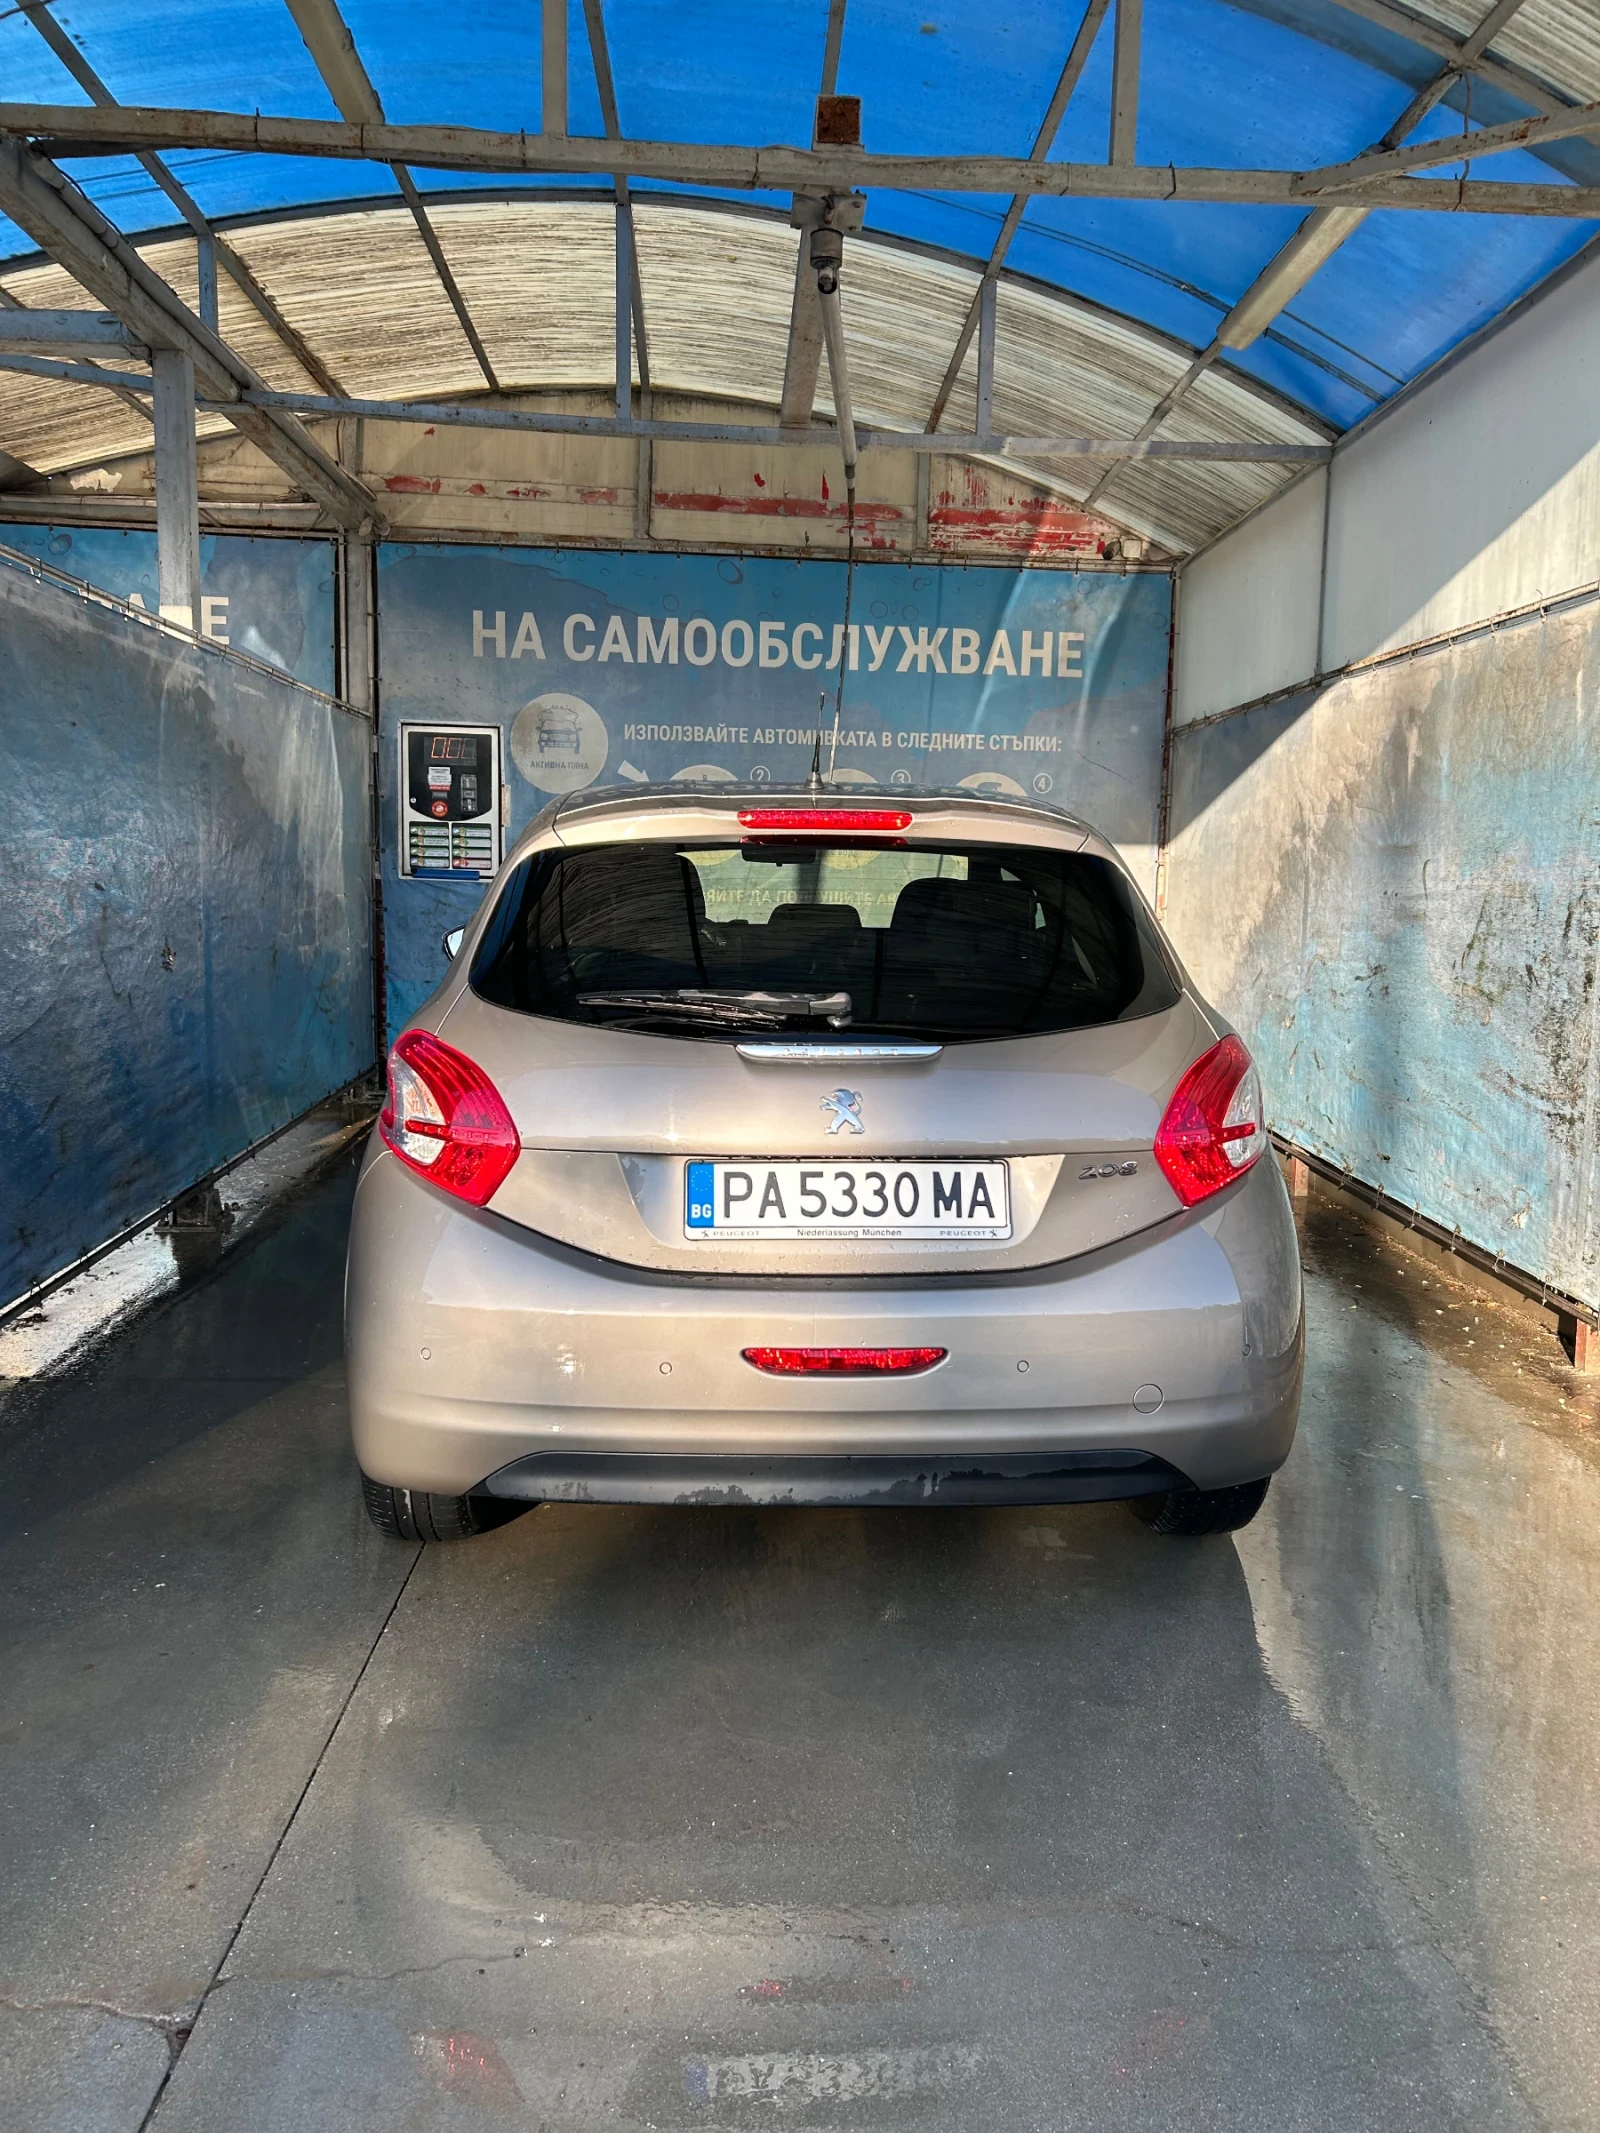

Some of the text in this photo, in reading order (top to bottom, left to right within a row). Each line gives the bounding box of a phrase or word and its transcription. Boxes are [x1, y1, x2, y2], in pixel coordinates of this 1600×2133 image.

[472, 609, 1085, 679] НА САМООБСЛУЖВАНЕ
[624, 723, 1062, 752] ИЗПОЛЗВАЙТЕ АВТОМИВКАТА В СЛЕДНИТЕ СТЪПКИ:
[530, 760, 589, 770] АКТИВНА ПЯНА
[1038, 778, 1046, 790] 4
[777, 889, 873, 905] ПОУШИТЕ
[1078, 1160, 1138, 1180] 208
[723, 1170, 996, 1219] PA 5330 MA
[691, 1203, 713, 1219] BG
[796, 1227, 902, 1239] Niederlassung München
